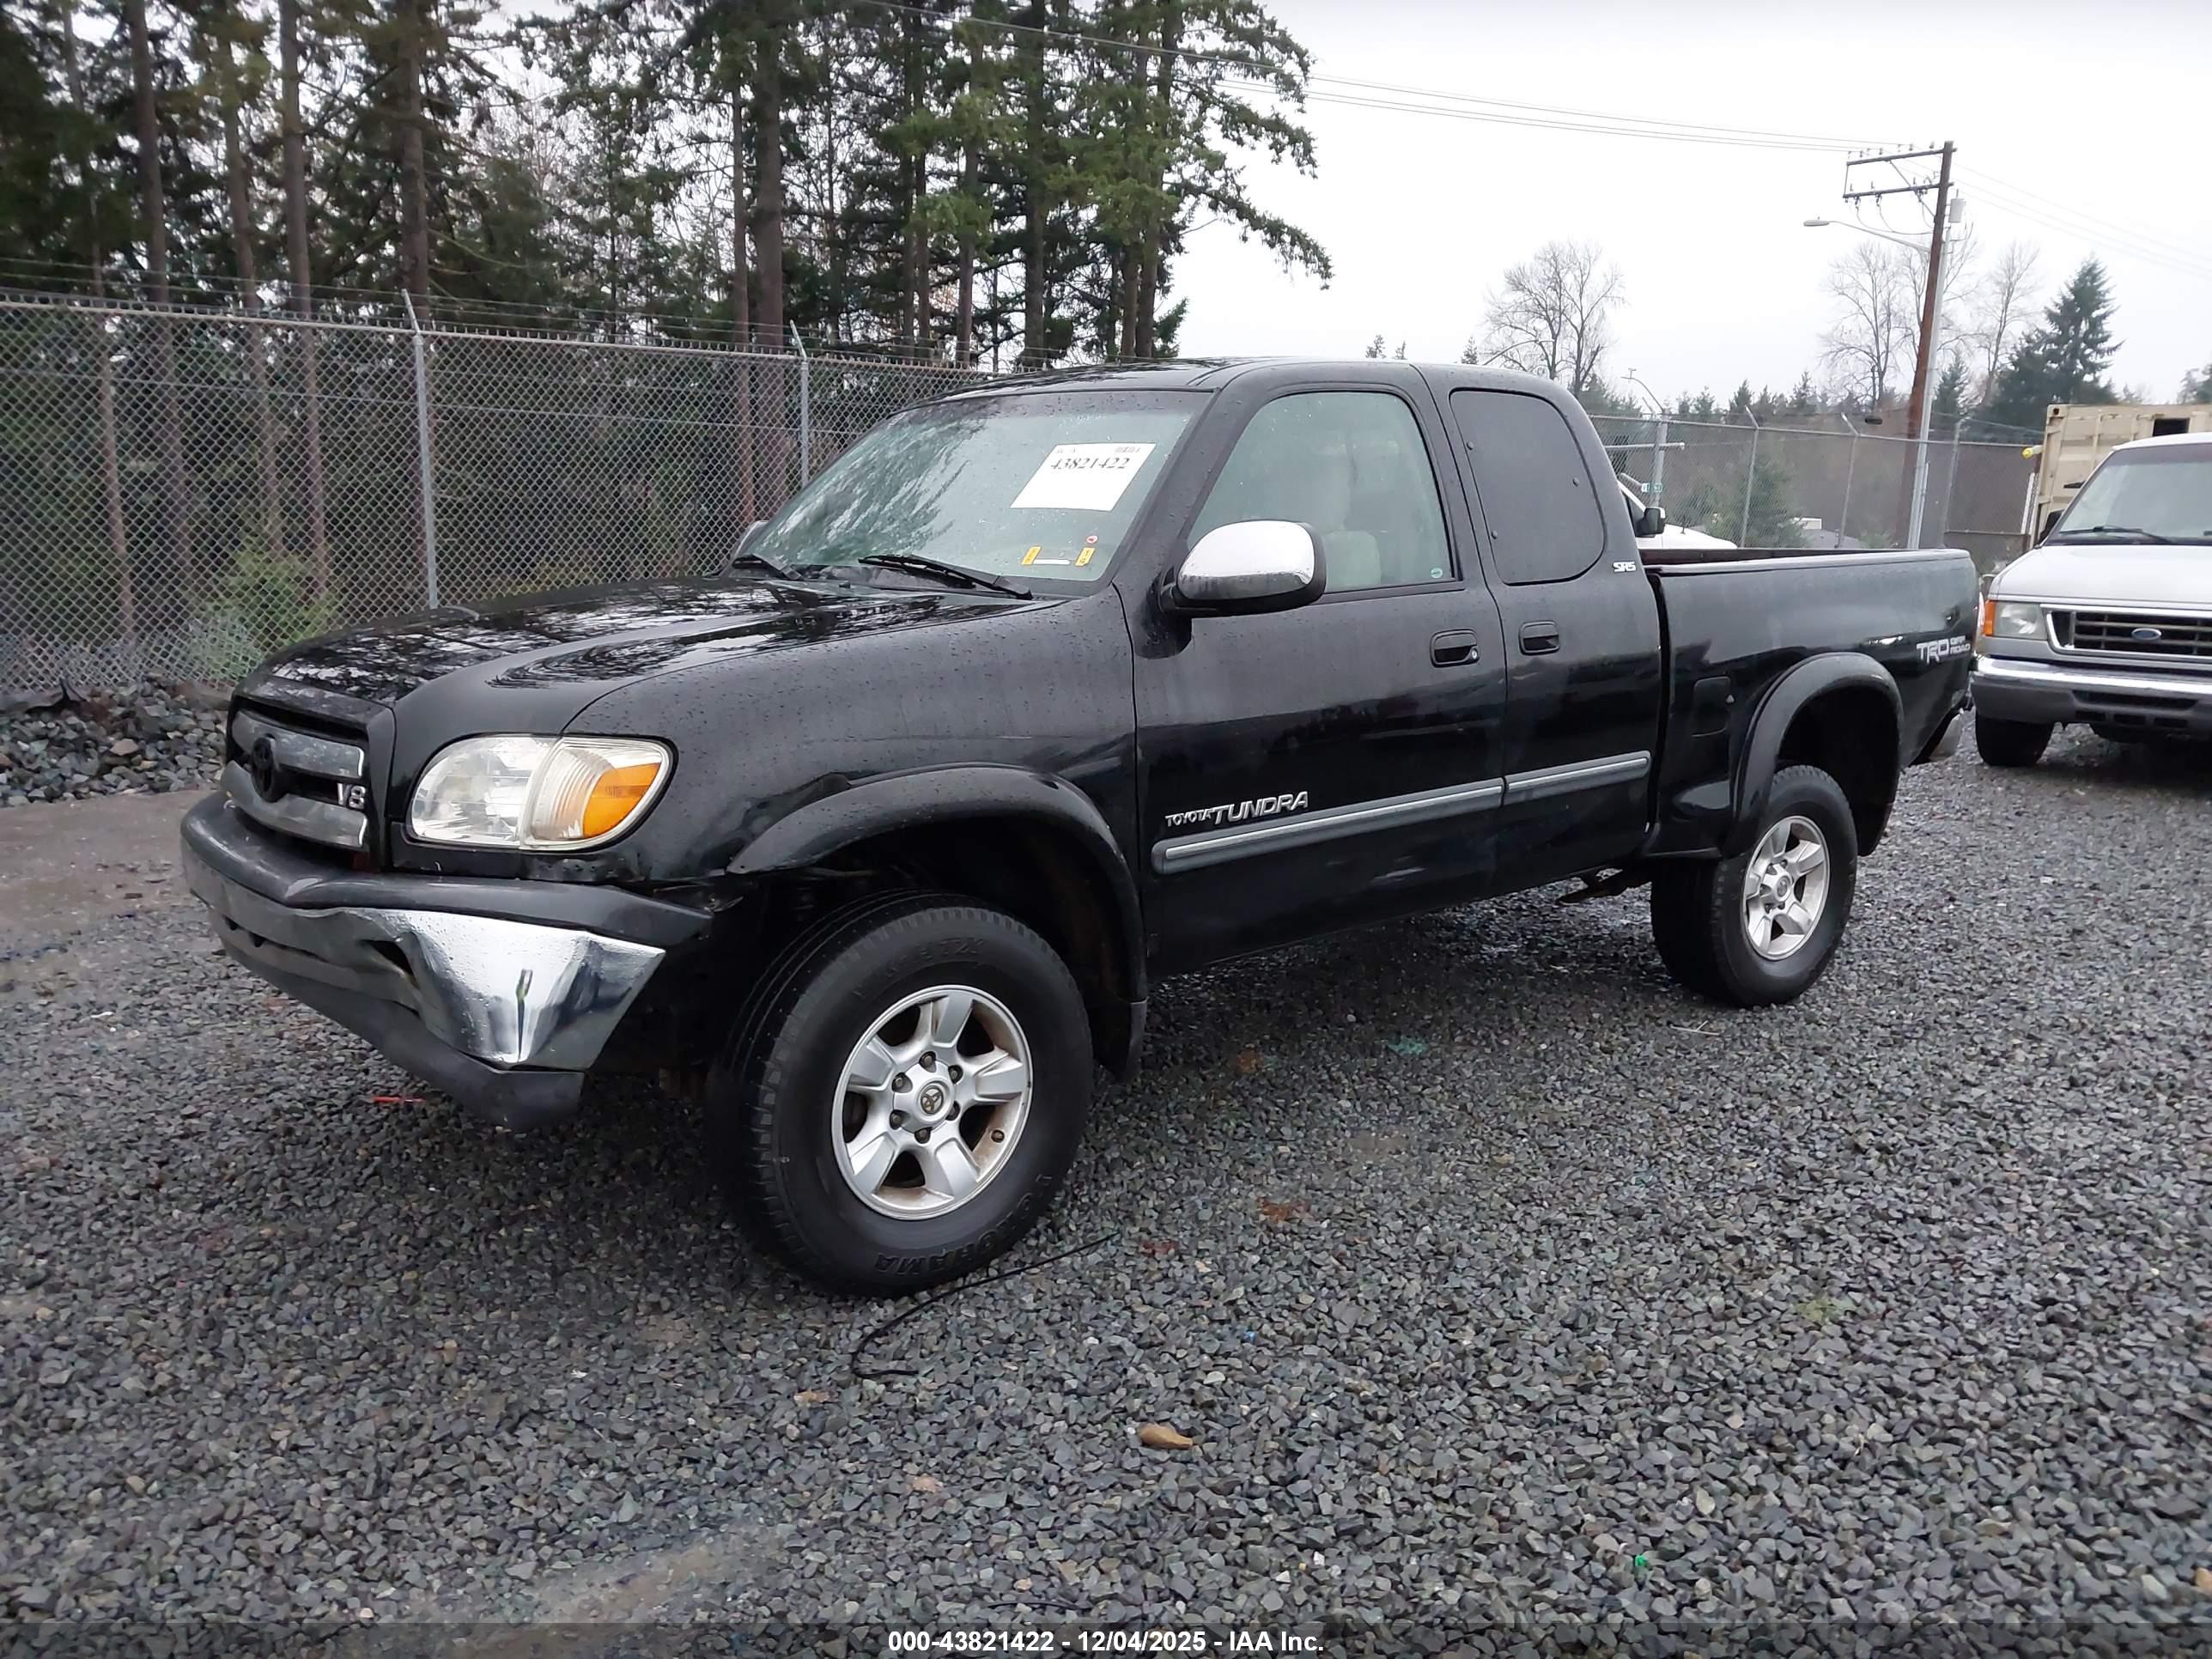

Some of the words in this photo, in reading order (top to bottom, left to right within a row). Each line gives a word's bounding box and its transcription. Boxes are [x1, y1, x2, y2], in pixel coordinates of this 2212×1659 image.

[1050, 457, 1130, 470] 43821422
[1613, 561, 1637, 573] SR5
[1916, 638, 1950, 665] TRD
[1950, 635, 1966, 645] OFF
[1950, 643, 1971, 654] ROAD
[337, 782, 367, 810] V8
[1165, 808, 1212, 827] TOYOTA
[1212, 791, 1309, 825] TUNDRA
